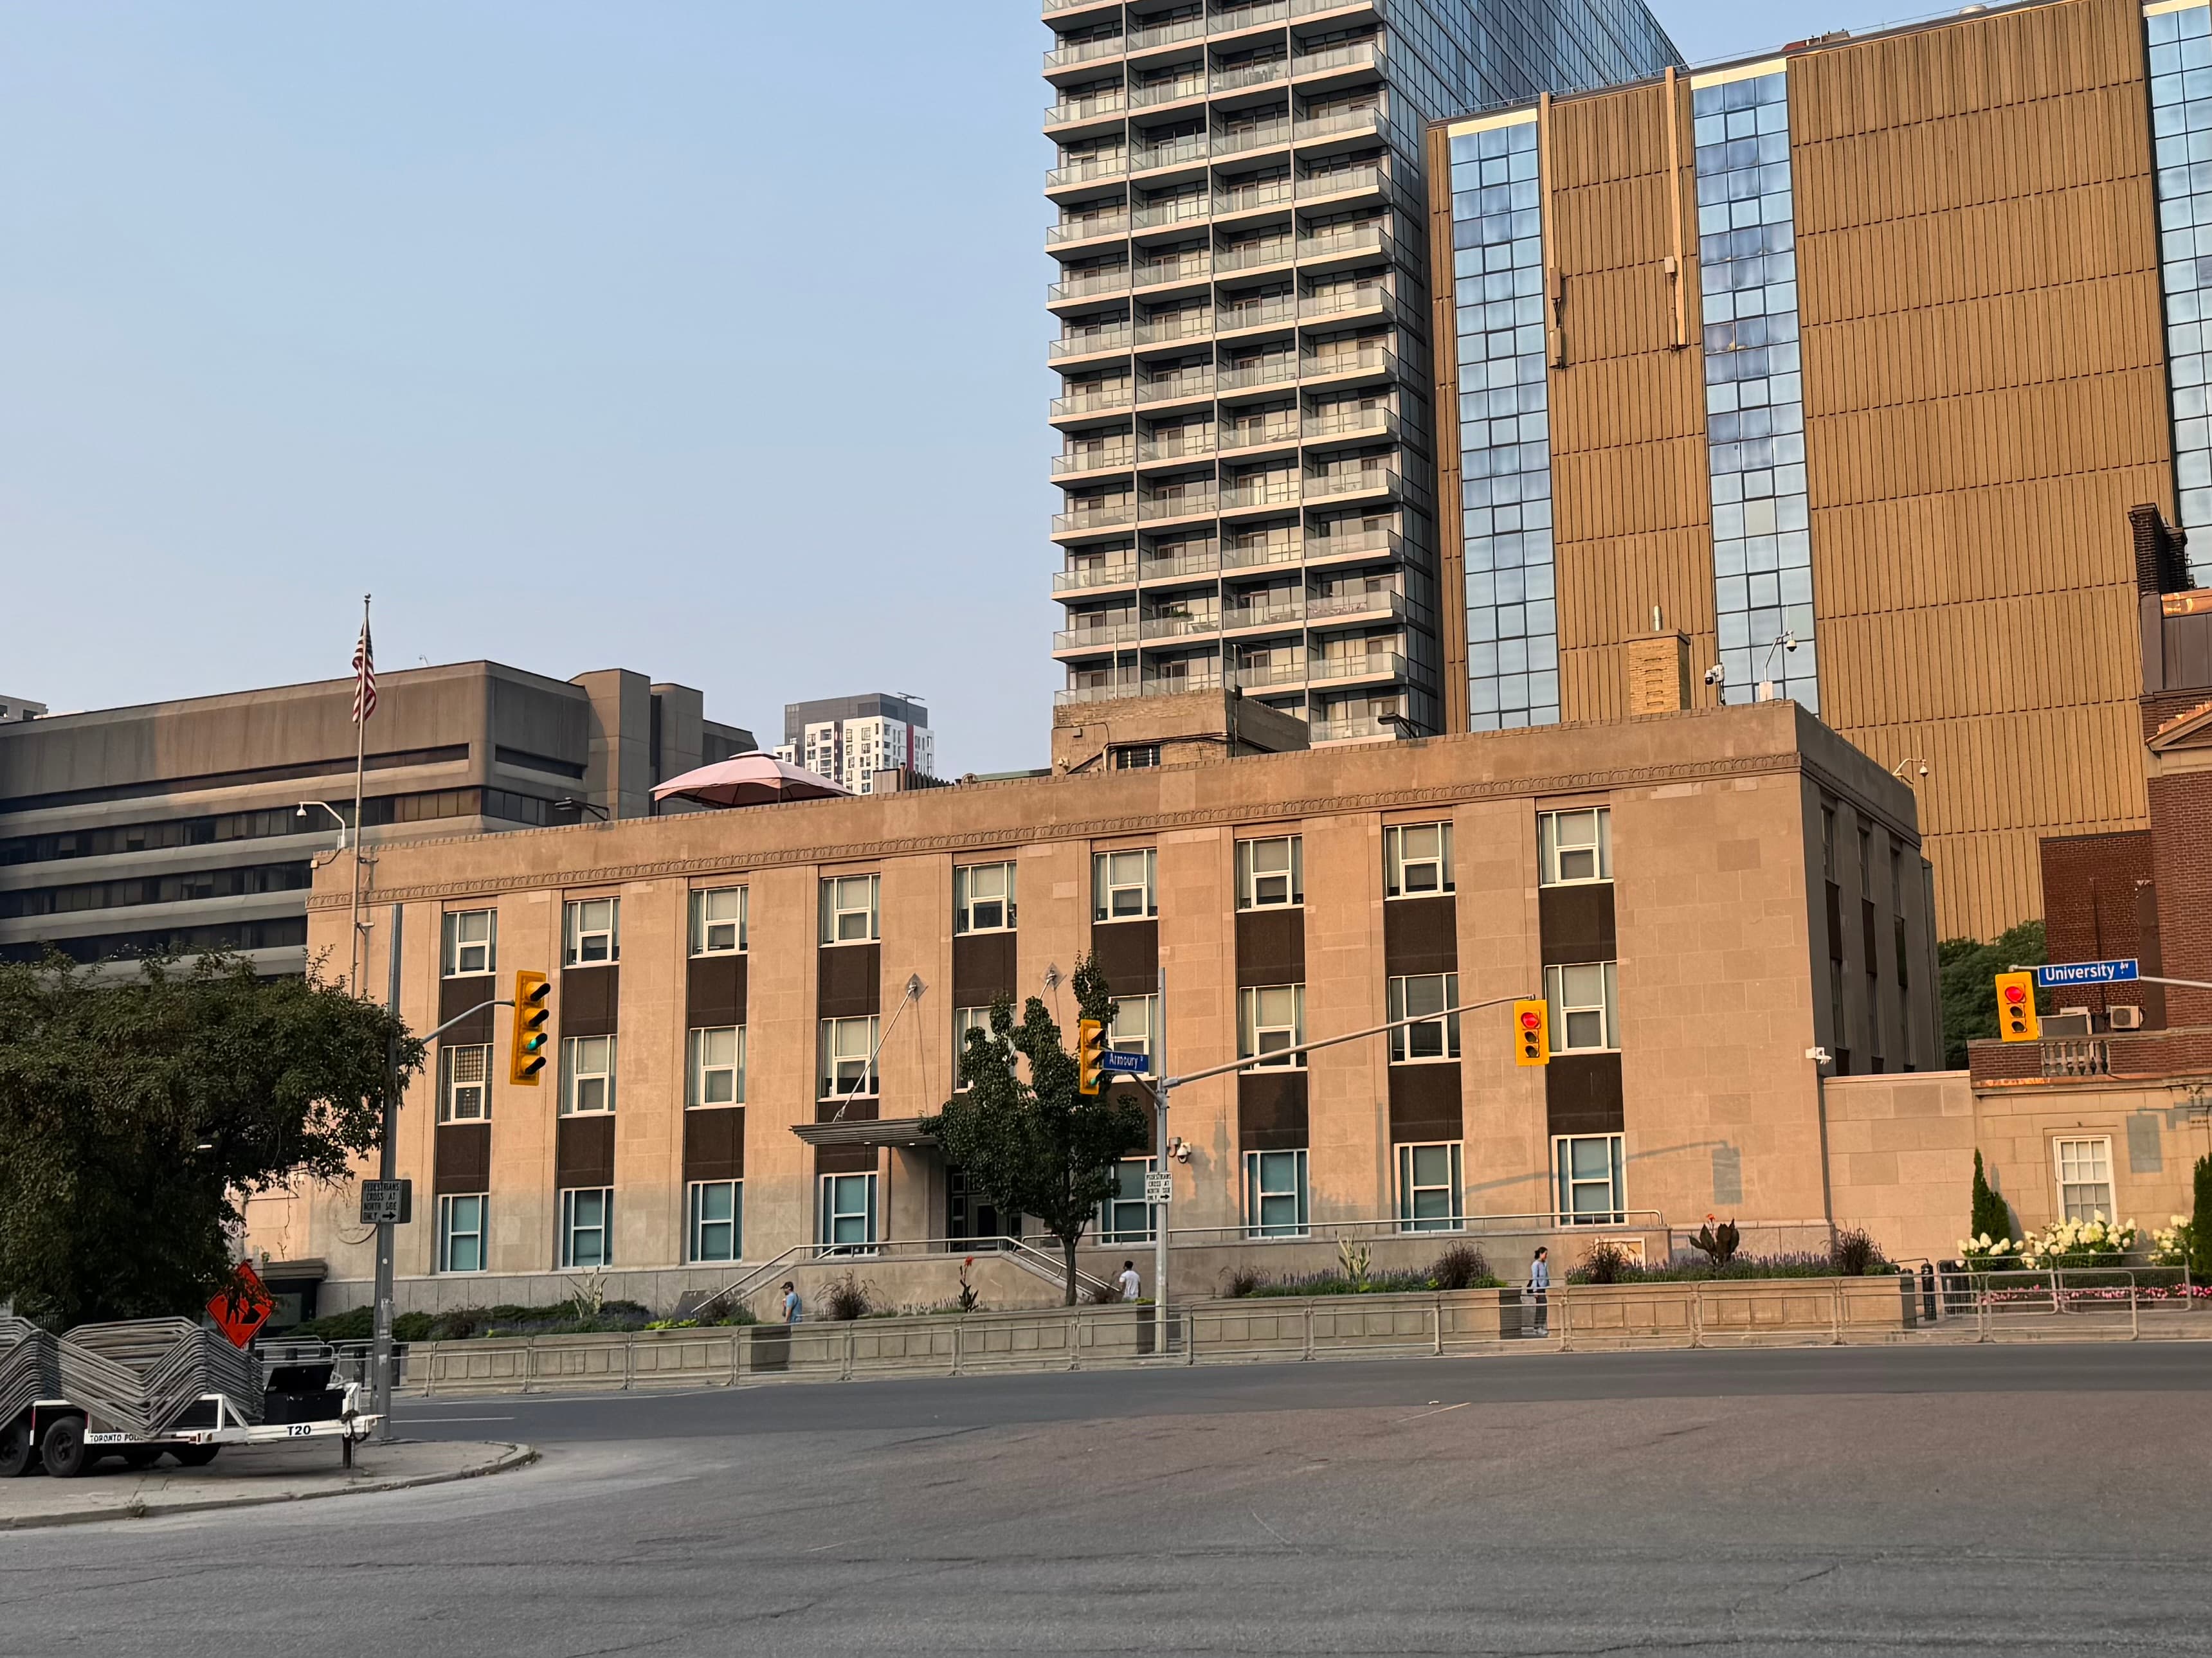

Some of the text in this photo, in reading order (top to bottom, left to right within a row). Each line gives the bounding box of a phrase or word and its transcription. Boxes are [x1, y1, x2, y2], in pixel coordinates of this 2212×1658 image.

[2045, 963, 2115, 981] University
[1109, 1053, 1138, 1070] Armoury
[367, 1192, 395, 1201] CROSS AT
[287, 1425, 311, 1436] T20
[90, 1434, 122, 1443] TORONTO
